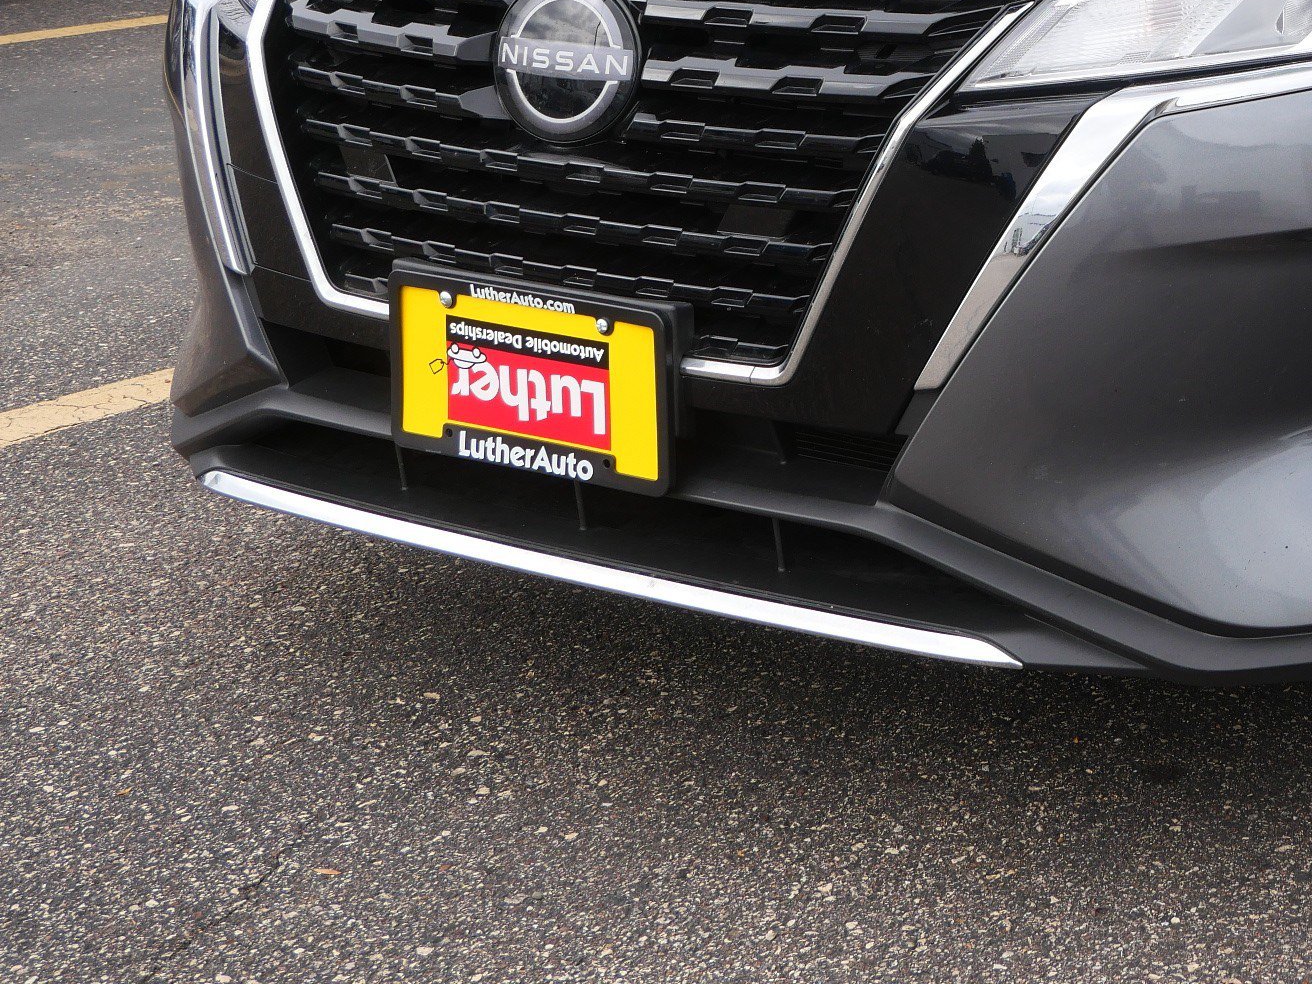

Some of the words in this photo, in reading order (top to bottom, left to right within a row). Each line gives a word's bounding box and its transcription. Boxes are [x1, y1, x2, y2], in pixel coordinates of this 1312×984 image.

[501, 42, 629, 76] NISSAN
[469, 284, 575, 314] LutherAuto.com
[450, 322, 522, 349] Dealerships
[525, 336, 605, 363] Automobile
[451, 359, 606, 435] Luther
[458, 431, 594, 481] LutherAuto
